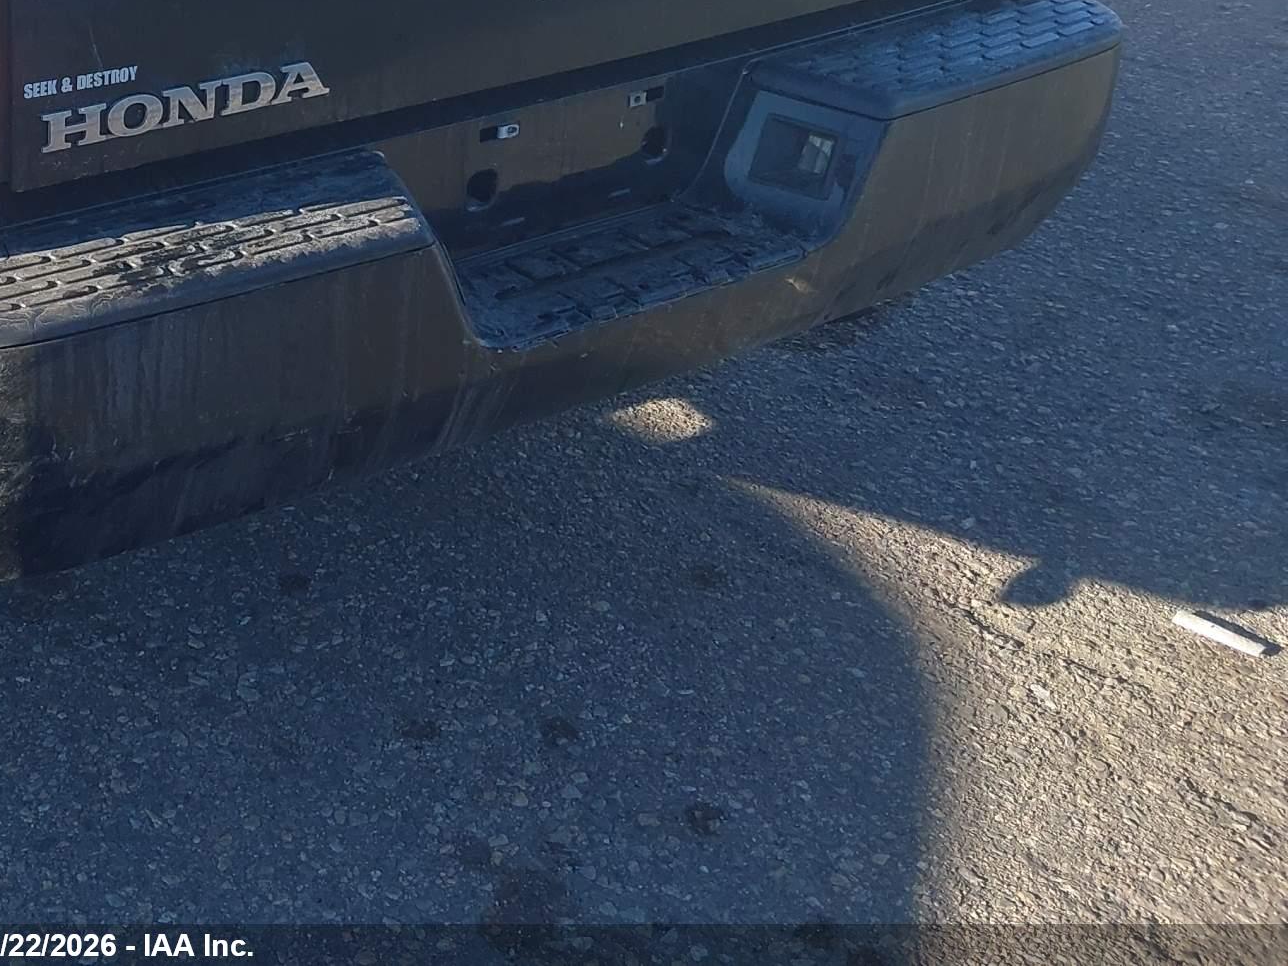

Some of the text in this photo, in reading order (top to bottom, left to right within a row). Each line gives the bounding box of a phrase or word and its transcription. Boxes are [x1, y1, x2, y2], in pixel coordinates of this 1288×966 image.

[23, 65, 138, 99] SEEK & DESTROY
[41, 61, 331, 153] HONDA
